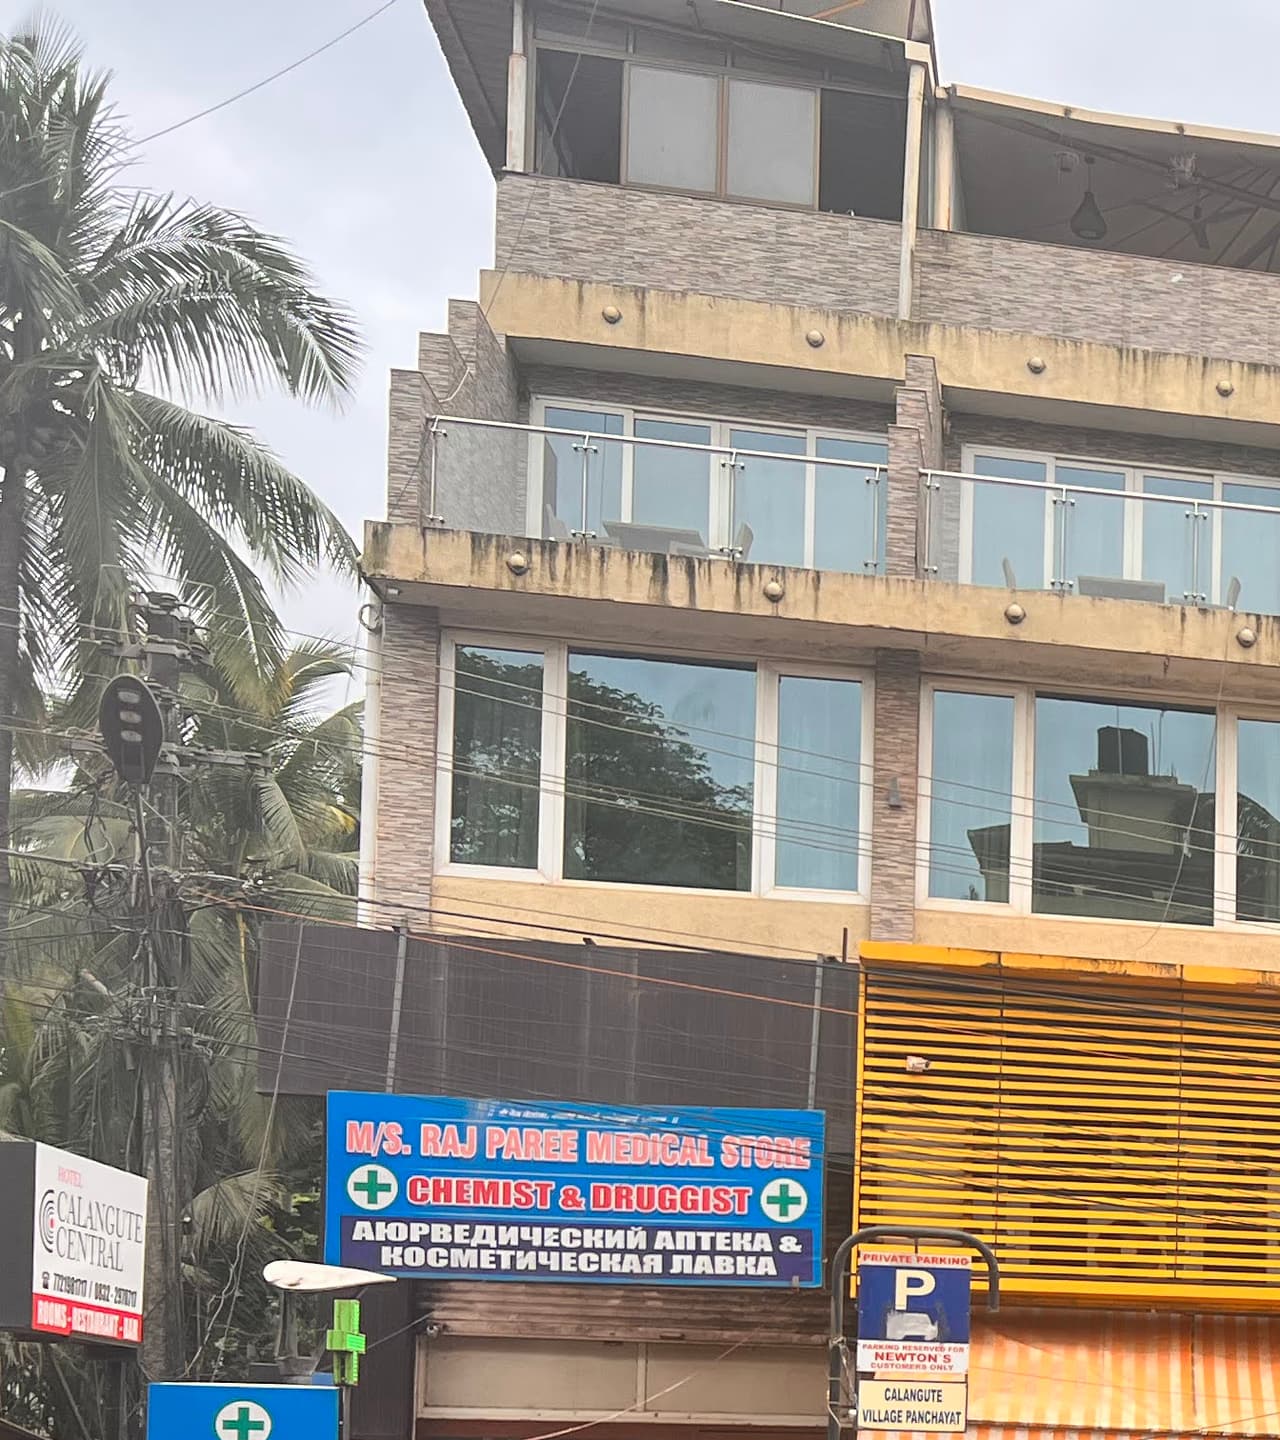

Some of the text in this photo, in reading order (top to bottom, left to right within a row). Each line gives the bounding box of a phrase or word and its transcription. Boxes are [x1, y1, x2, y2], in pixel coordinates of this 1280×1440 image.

[346, 1120, 811, 1169] M/S. RAJ PAREE MEDICAL STORE
[407, 1175, 752, 1215] CHEMIST & DRUGGIST
[56, 1190, 144, 1243] CALANGUTE
[56, 1226, 124, 1272] CENTRAL
[352, 1220, 802, 1253] АЮРВЕДИЧЕСКИЙ АПТЕКА &
[380, 1246, 777, 1276] КОСМЕТИЧЕСКАЯ ЛАВКА
[863, 1253, 970, 1266] PRIVATE PARKING
[895, 1268, 936, 1311] P
[862, 1343, 899, 1351] PARKING
[902, 1344, 946, 1352] RESERVED
[870, 1362, 927, 1370] CUSTOMERS
[884, 1387, 943, 1403] CALANGUTE
[862, 1409, 962, 1426] VILLAGE PANCHAYAT
